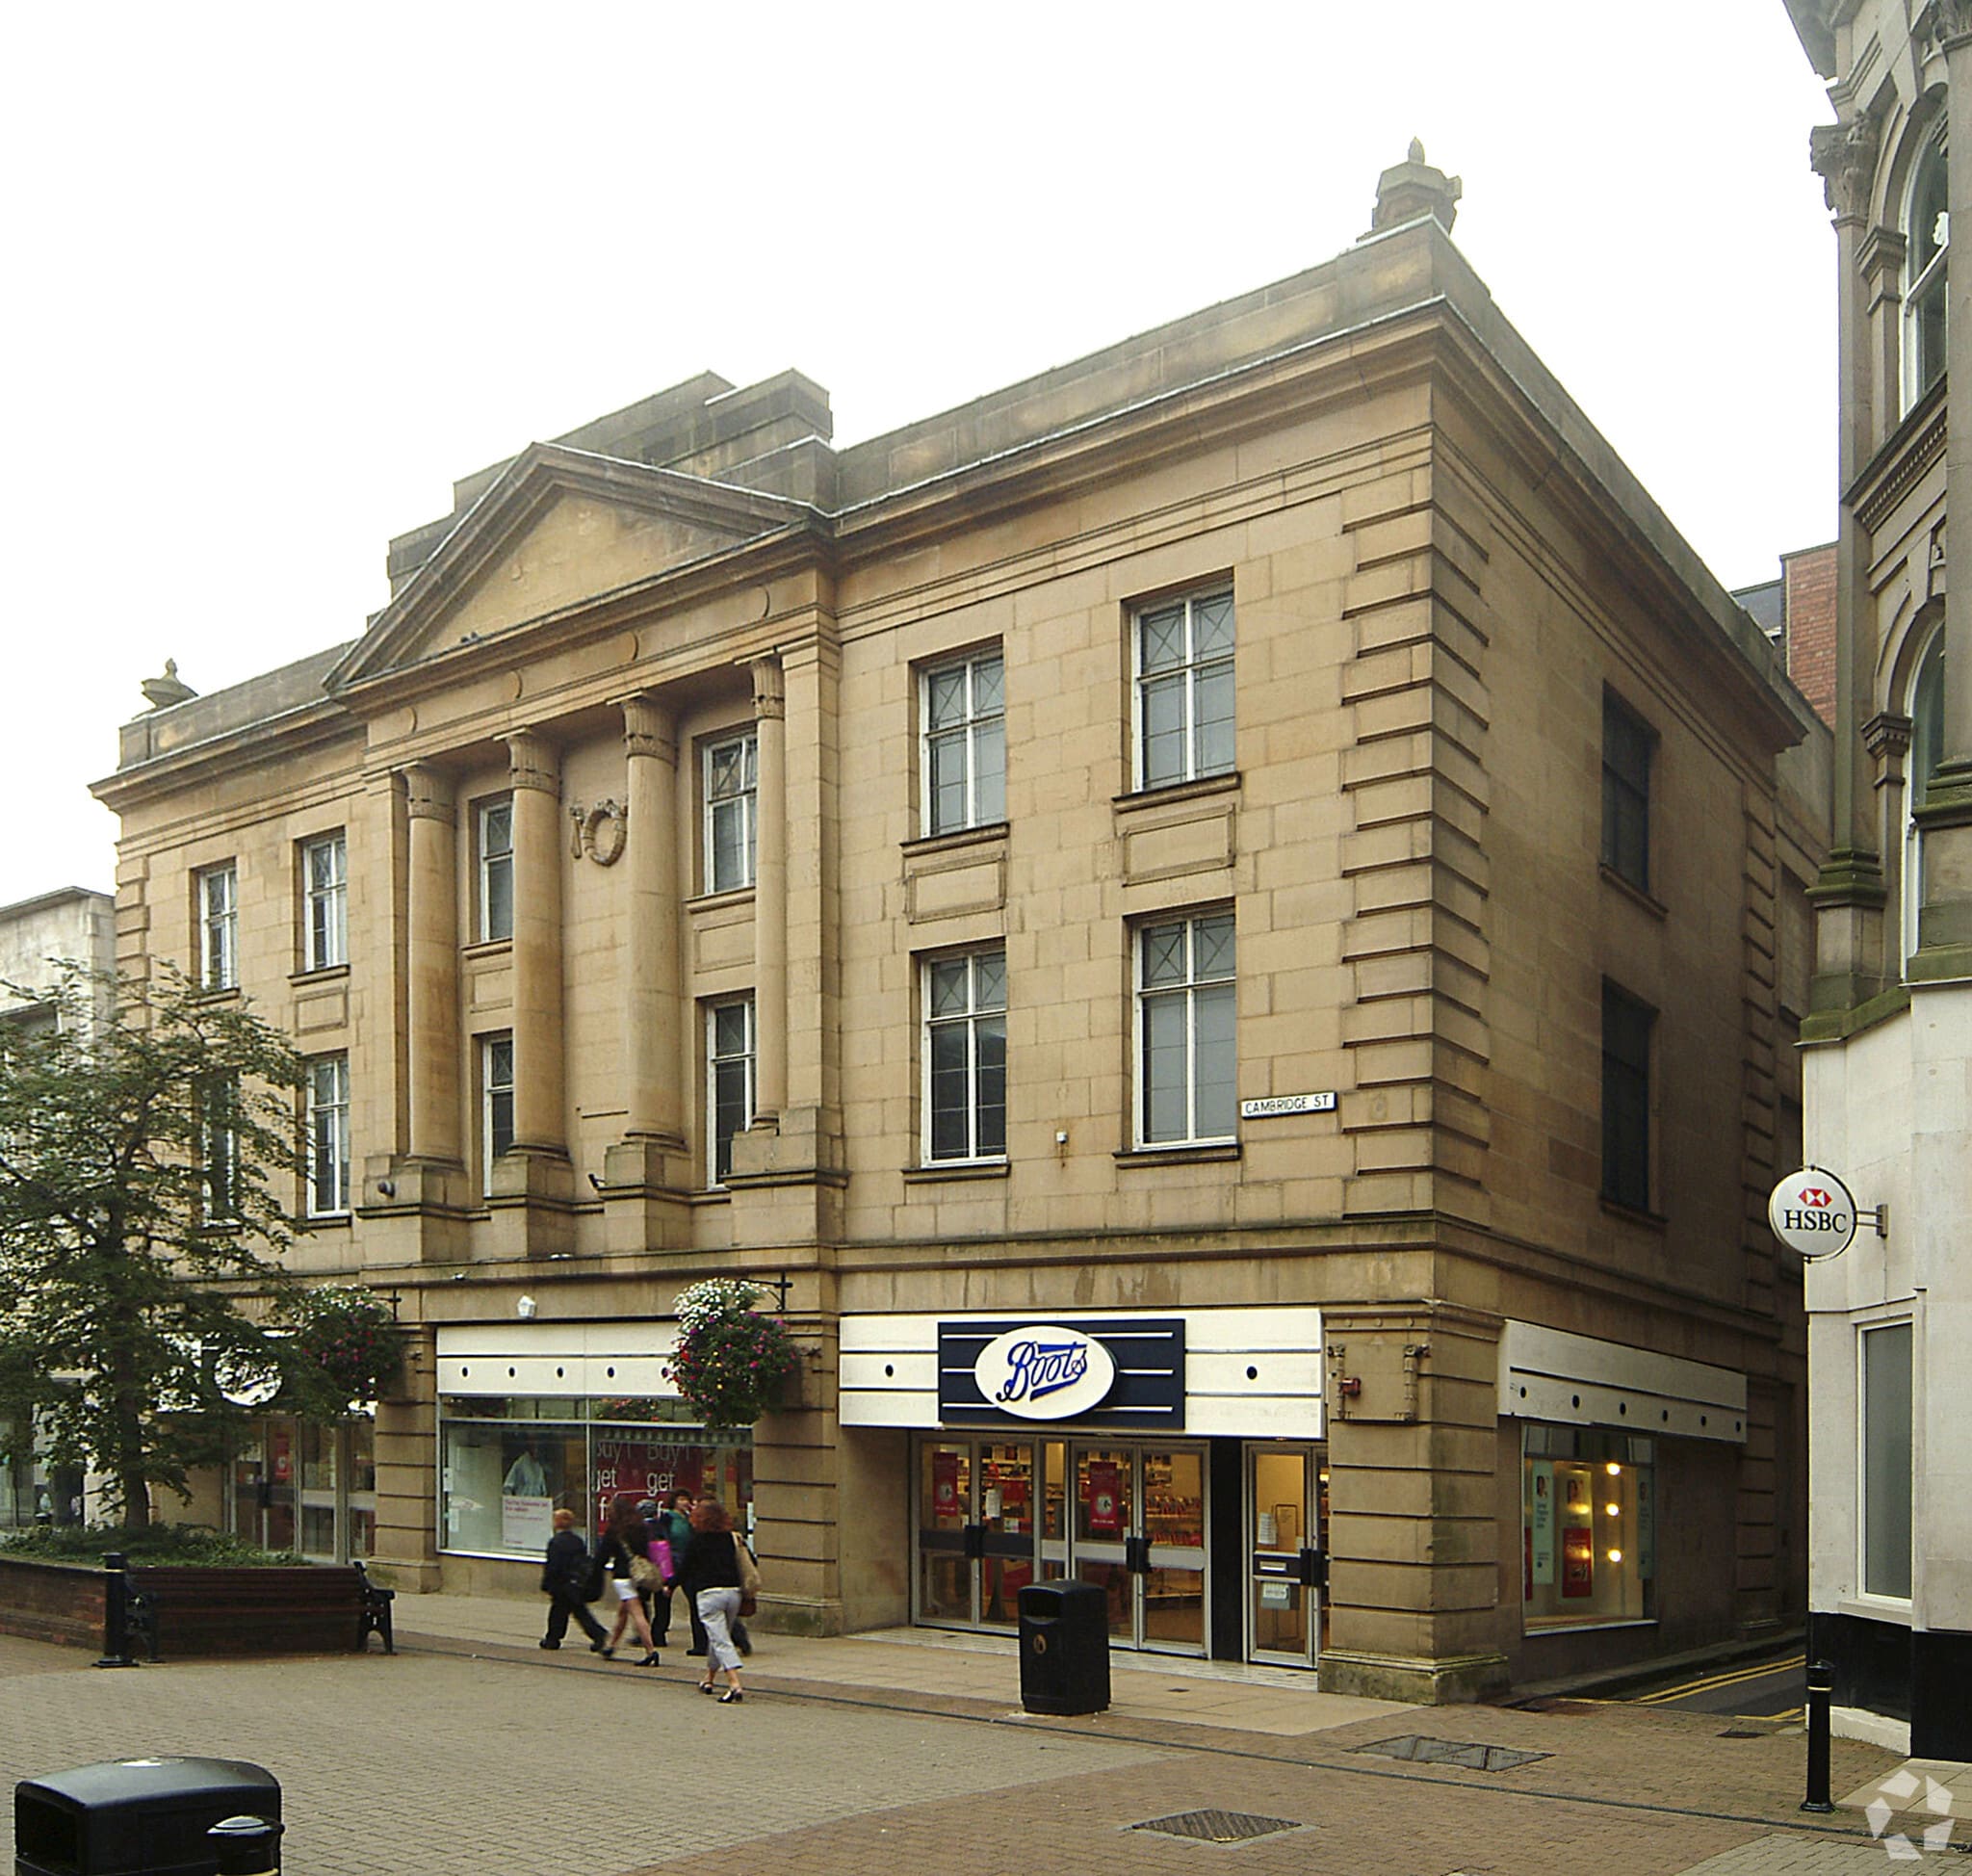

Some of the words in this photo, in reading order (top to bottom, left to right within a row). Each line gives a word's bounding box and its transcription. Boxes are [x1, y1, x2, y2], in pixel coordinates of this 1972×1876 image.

[1245, 1097, 1308, 1114] CAMBRIDGE
[1313, 1095, 1329, 1107] ST
[1783, 1210, 1847, 1234] HSBC
[996, 1341, 1087, 1402] Boots
[646, 1471, 675, 1497] get
